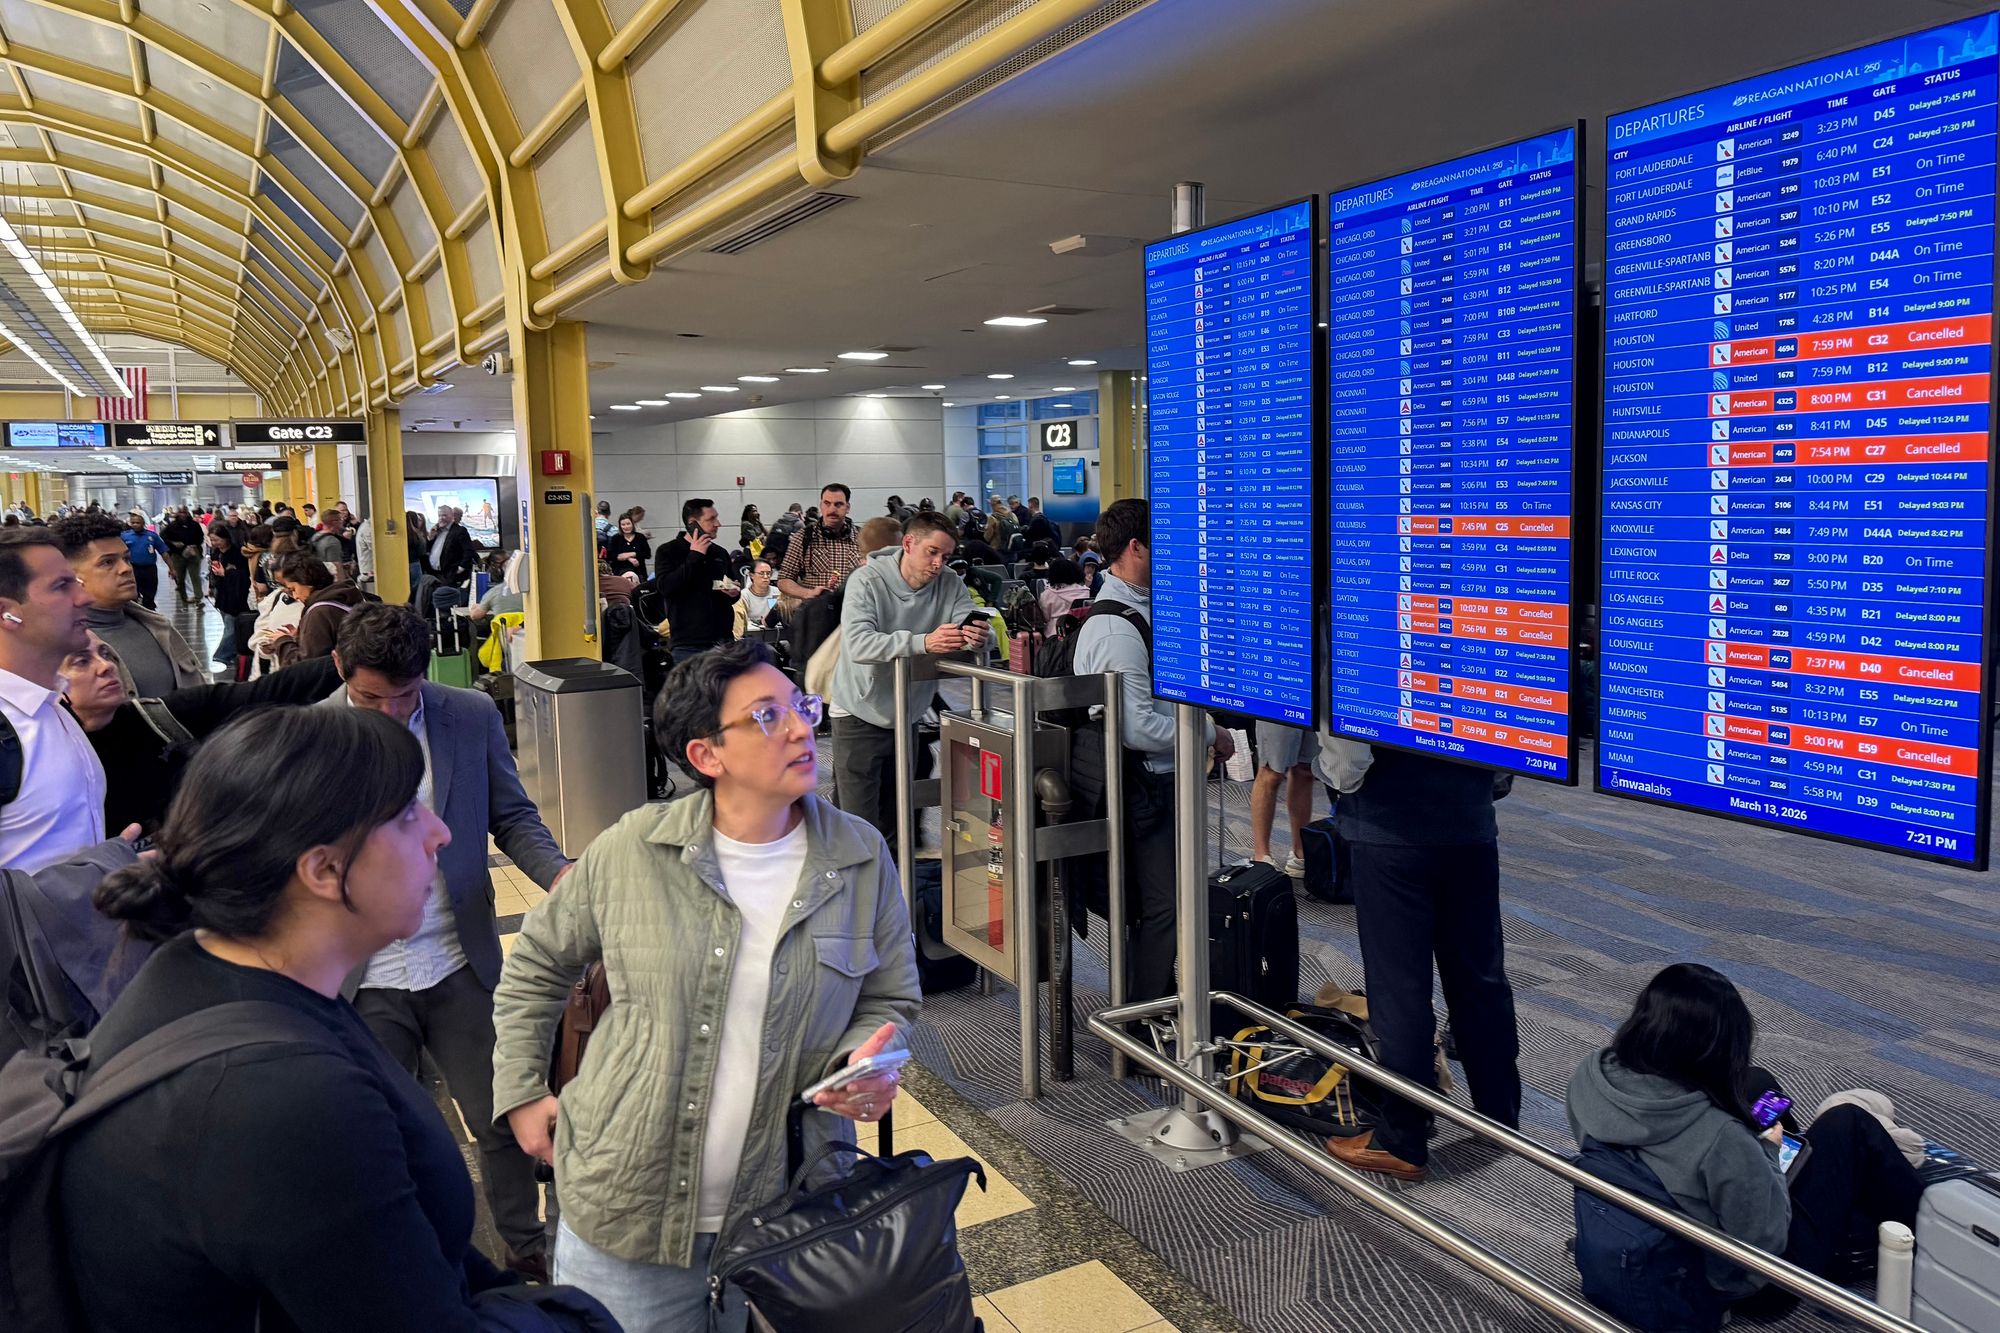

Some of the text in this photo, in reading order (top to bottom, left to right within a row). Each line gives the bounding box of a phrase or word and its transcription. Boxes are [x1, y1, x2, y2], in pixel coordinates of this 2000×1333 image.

[1614, 150, 1628, 160] CITY
[1726, 118, 1756, 133] AIRLINE
[1763, 109, 1792, 124] FLIGHT
[1827, 96, 1848, 109] TIME
[1872, 84, 1896, 98] GATE
[1924, 68, 1960, 86] STATUS
[1615, 103, 1704, 140] DEPARTURES
[1616, 89, 1975, 179] FORT LAUDERDALE American 3249 3:23 PM D45 Delayed 7:45 PM
[1334, 221, 1344, 230] CITY
[1407, 201, 1426, 211] AIRLINE
[1430, 195, 1448, 206] FLIGHT
[1470, 186, 1483, 196] TIME
[1498, 179, 1512, 189] GATE
[1529, 169, 1551, 181] STATUS
[1335, 187, 1393, 212] DEPARTURES
[1615, 150, 1965, 227] GRAND RAPIDS American 5190 10:03 PM E51 On Time
[1335, 232, 1361, 246] CHICAGO,
[1362, 229, 1375, 239] ORD
[1414, 216, 1430, 226] United
[1464, 205, 1478, 215] 2:00
[1479, 202, 1489, 211] PM
[1499, 197, 1511, 207] B11
[1520, 190, 1540, 202] Delayed
[1280, 235, 1295, 243] STATUS
[1148, 243, 1189, 262] DEPARTURES
[1277, 251, 1285, 260] On
[1286, 248, 1297, 258] Time
[1613, 357, 1653, 369] HOUSTON
[1734, 347, 1768, 357] American
[1812, 339, 1833, 350] 7:59
[1836, 337, 1852, 348] PM
[1868, 334, 1888, 345] C32
[1908, 326, 1963, 342] Cancelled
[269, 426, 332, 439] Gate C23
[1047, 424, 1070, 447] C23
[1611, 501, 1642, 509] KANSAS
[1644, 501, 1662, 509] CITY
[1809, 500, 1829, 510] 8:44
[1832, 500, 1848, 509] PM
[1864, 500, 1882, 510] E51
[1898, 501, 1930, 510] Delayed
[1520, 523, 1553, 531] Cancelled
[1610, 547, 1656, 557] LEXINGTON
[1808, 553, 1828, 563] 9:00
[1831, 554, 1847, 563] PM
[1863, 555, 1883, 564] B20
[1905, 556, 1921, 566] On
[1924, 556, 1953, 567] Time
[1336, 594, 1358, 602] DAYTON
[1460, 604, 1476, 612] 10:02
[1477, 605, 1488, 613] PM
[1495, 606, 1507, 615] E52
[1519, 608, 1552, 618] Cancelled
[1609, 638, 1653, 650] LOUISVILLE
[1728, 651, 1762, 661] American
[1806, 657, 1826, 668] 7:37
[1829, 659, 1844, 669] PM
[1860, 662, 1881, 673] D40
[1899, 665, 1953, 680] Cancelled
[1211, 695, 1225, 704] March
[1284, 709, 1304, 719] 7:21 PM
[1415, 735, 1464, 752] March 13, 2026
[1608, 706, 1950, 765] MEMPHIS American 4681 9:00 PM E59 Cancelled
[1525, 757, 1556, 771] 7:20 PM
[1619, 776, 1671, 797] mwaalabs
[1730, 796, 1807, 821] March 13, 2026
[1906, 830, 1956, 850] 7:21 PM
